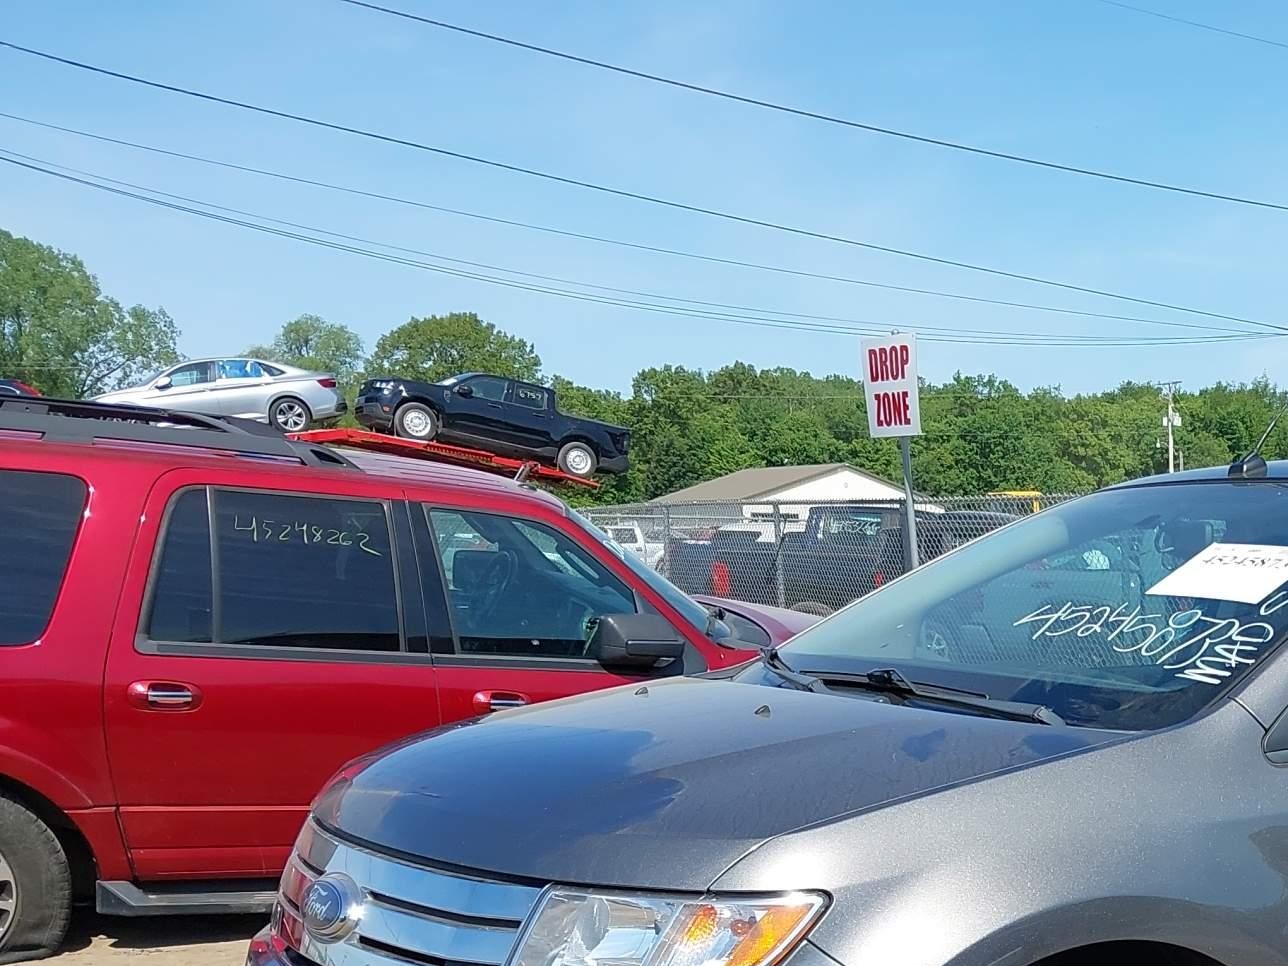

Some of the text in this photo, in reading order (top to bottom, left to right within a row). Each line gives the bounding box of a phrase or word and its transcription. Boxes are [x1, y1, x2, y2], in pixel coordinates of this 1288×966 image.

[867, 344, 910, 383] DROP
[873, 390, 912, 428] ZONE
[233, 513, 384, 557] 45248262
[301, 884, 332, 921] Ford
